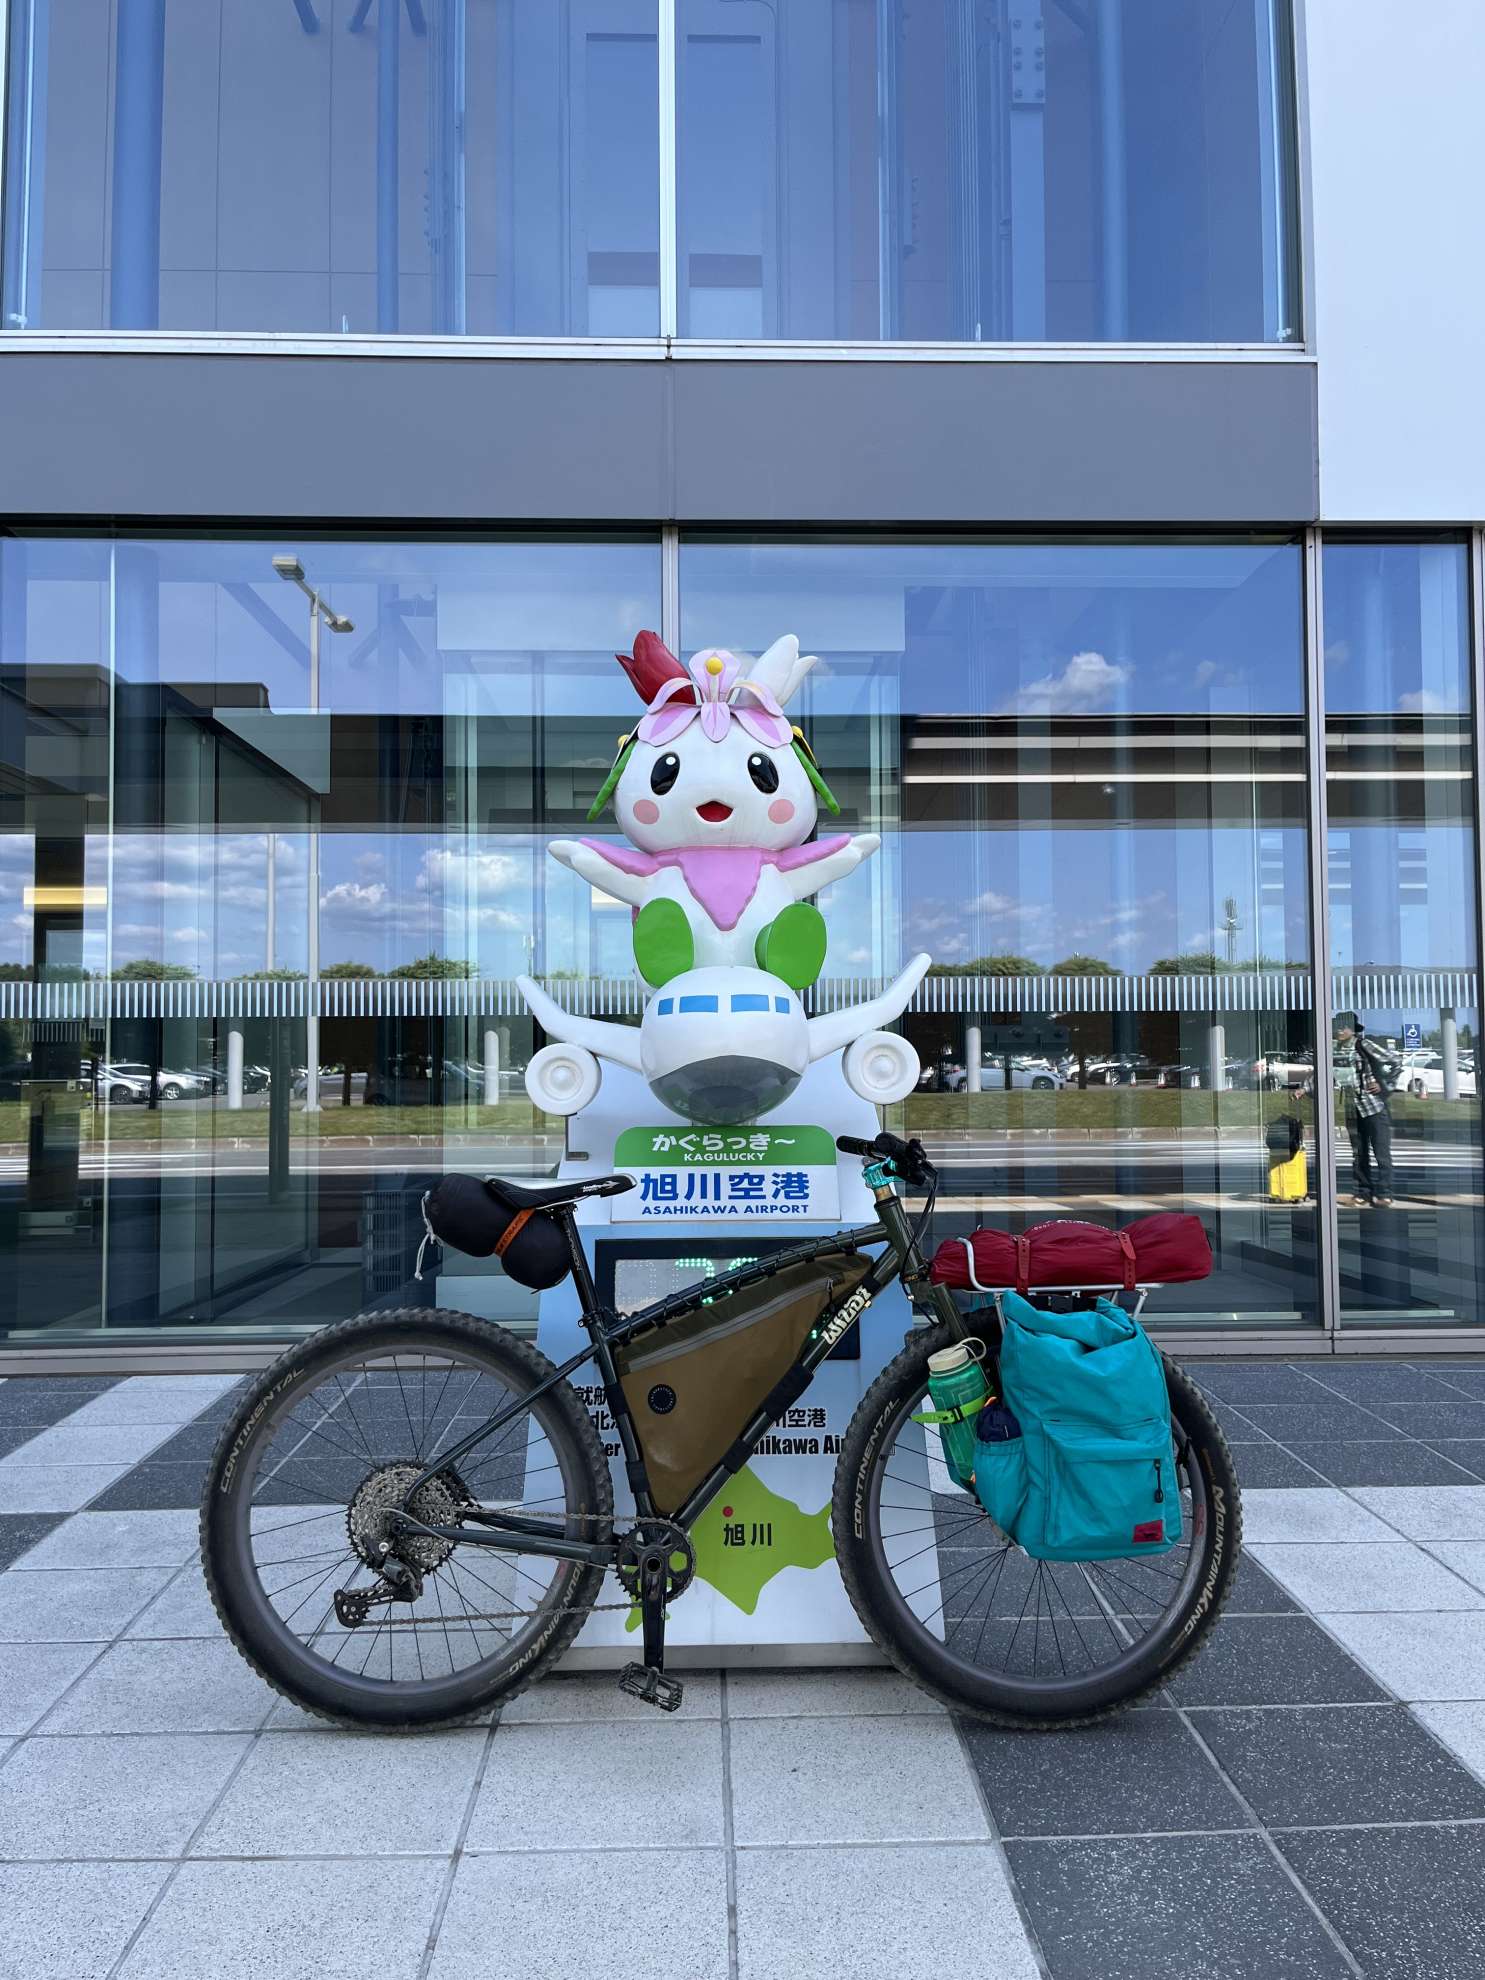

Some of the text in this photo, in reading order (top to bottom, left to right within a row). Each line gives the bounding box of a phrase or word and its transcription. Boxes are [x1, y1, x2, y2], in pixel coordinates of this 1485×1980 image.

[684, 1152, 765, 1161] KAGULUCKY
[640, 1172, 810, 1201] 旭川空港
[641, 1204, 809, 1215] ASAHIKAWA AIRPORT
[220, 1368, 305, 1494] CONTINENTAL
[600, 1442, 621, 1457] er
[854, 1398, 900, 1540] CONTINENTAL
[723, 1522, 772, 1547] 旭川
